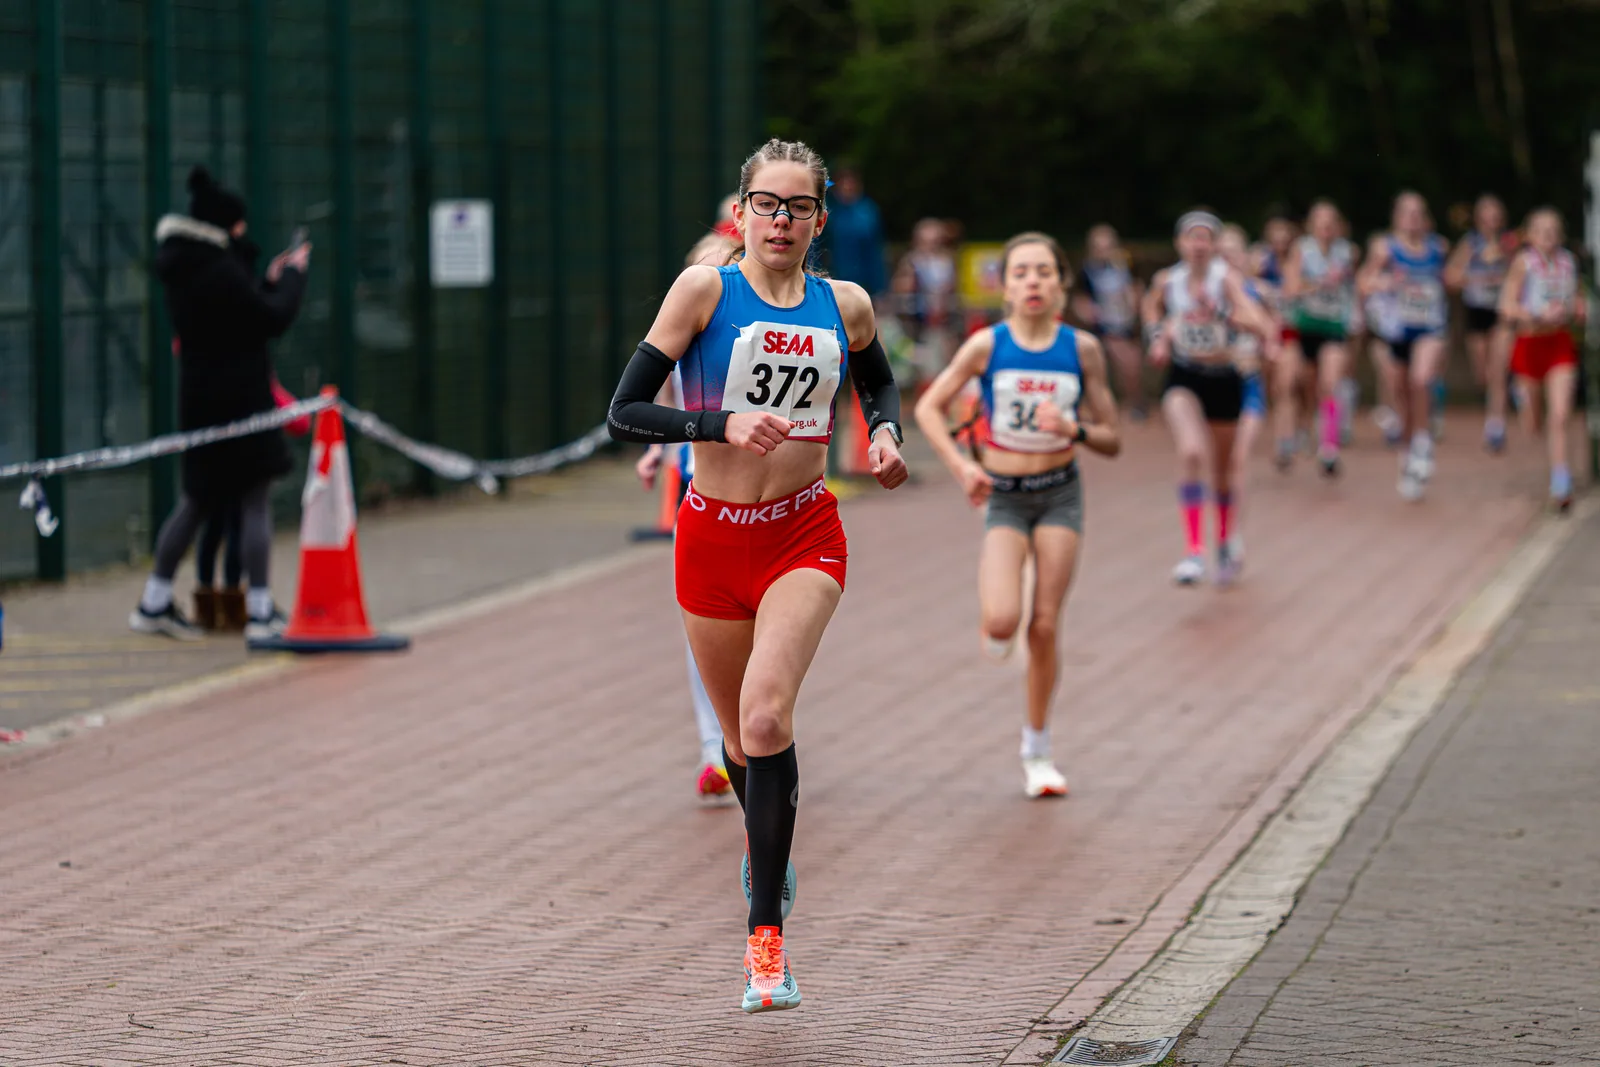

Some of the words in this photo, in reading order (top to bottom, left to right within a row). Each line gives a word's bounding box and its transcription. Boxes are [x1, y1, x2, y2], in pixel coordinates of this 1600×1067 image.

[763, 330, 814, 357] SEAA
[746, 363, 820, 409] 372
[718, 500, 790, 525] NIKE
